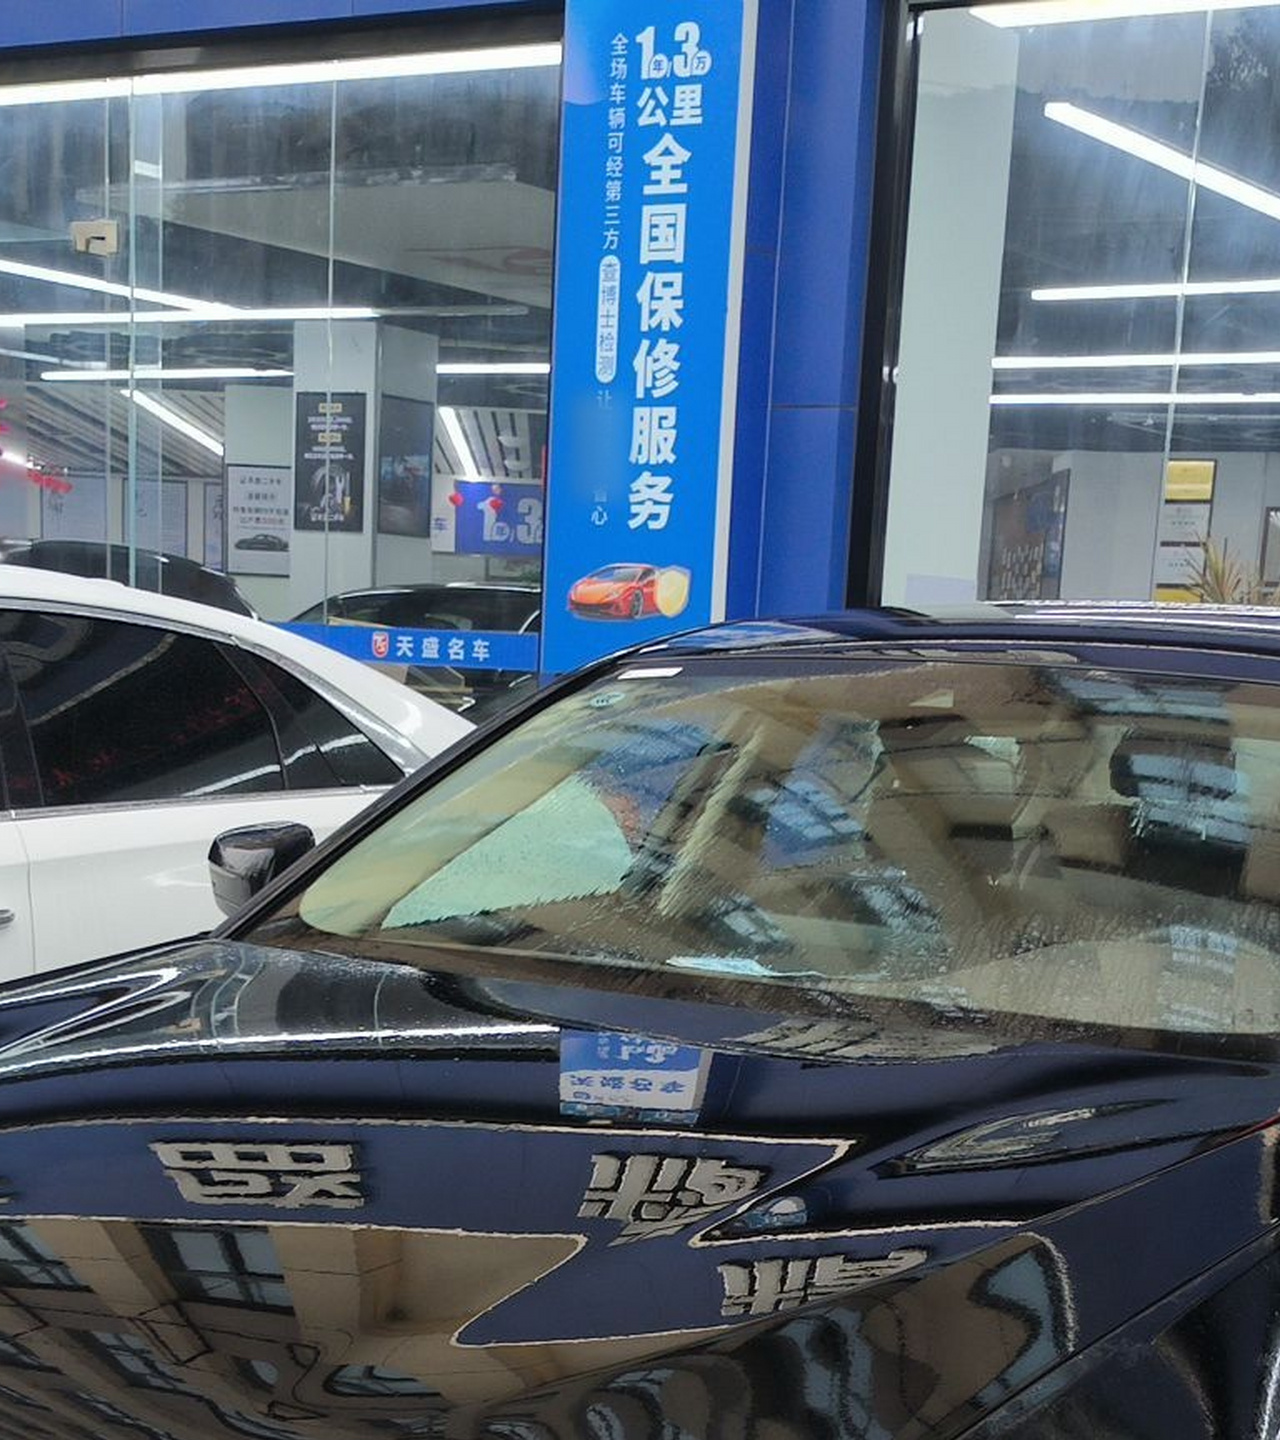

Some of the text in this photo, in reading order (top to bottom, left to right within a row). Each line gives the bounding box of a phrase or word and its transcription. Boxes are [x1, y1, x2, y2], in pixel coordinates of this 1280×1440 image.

[603, 33, 629, 250] 全场车辆可经第三方
[636, 84, 703, 128] 公里
[627, 133, 692, 530] 全国保修服务
[396, 635, 491, 661] 天盛名车
